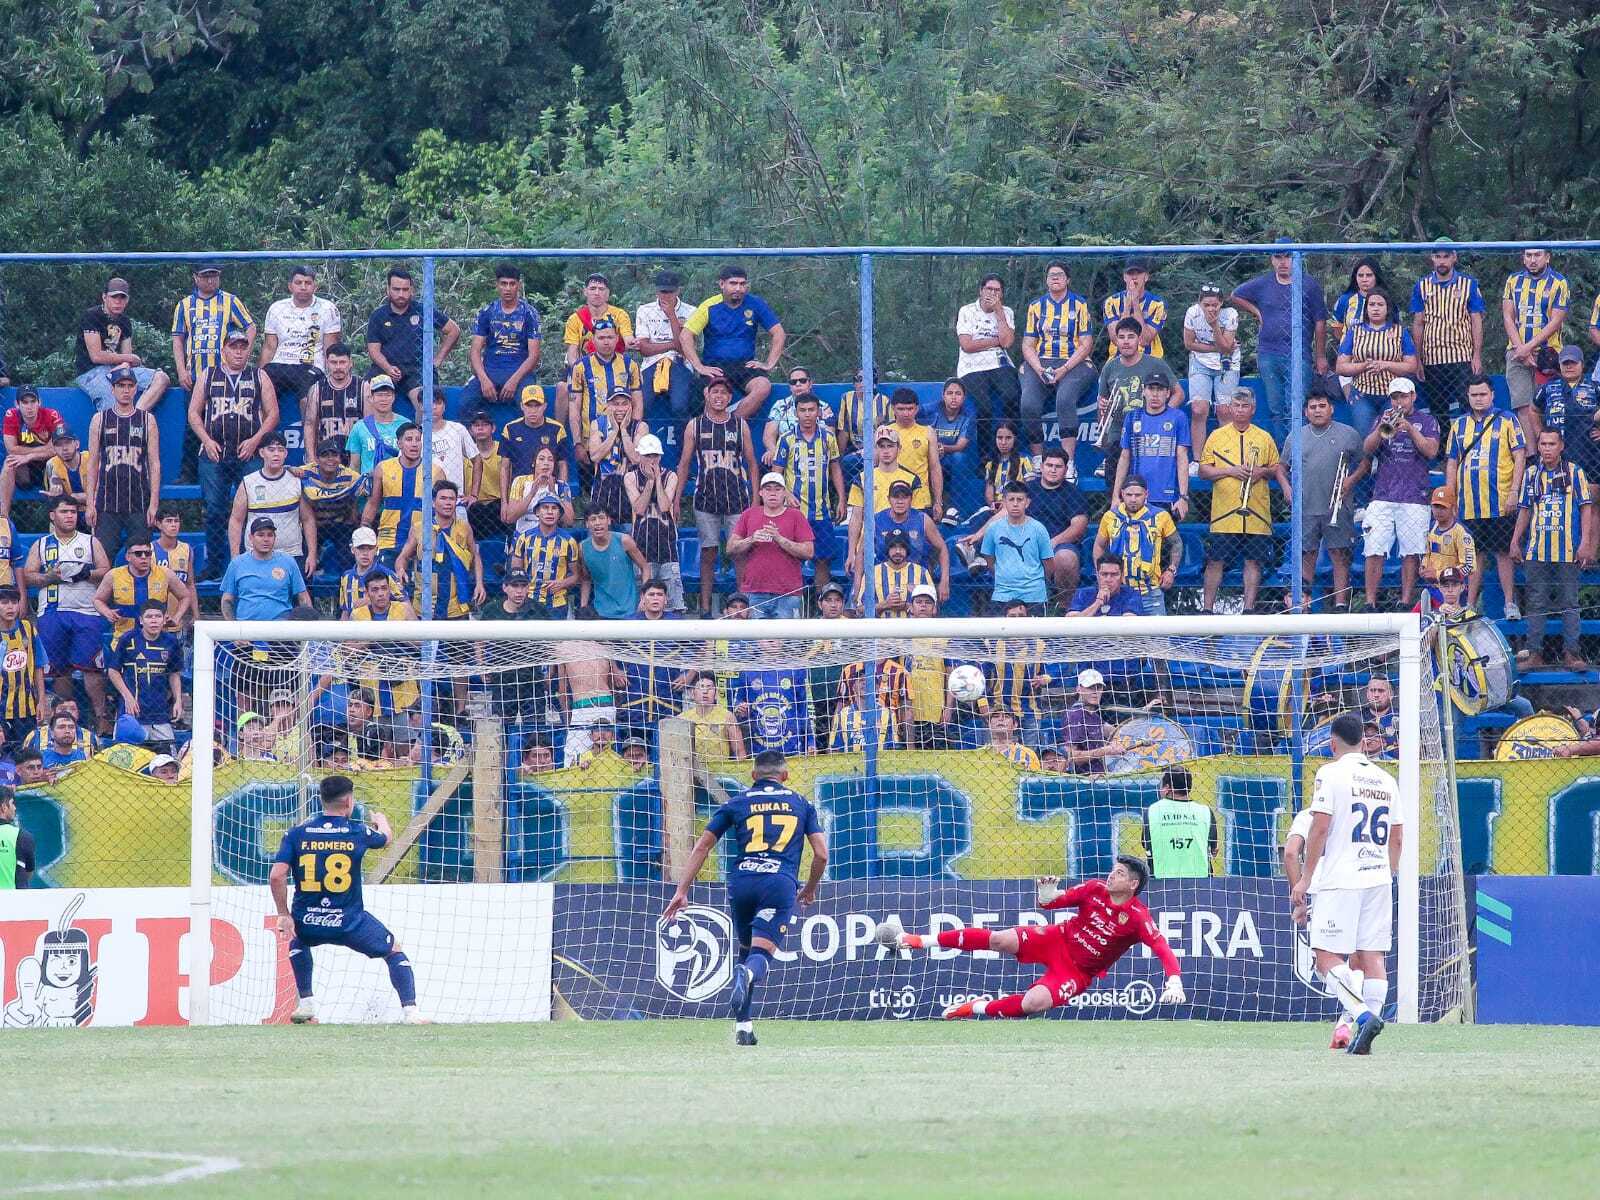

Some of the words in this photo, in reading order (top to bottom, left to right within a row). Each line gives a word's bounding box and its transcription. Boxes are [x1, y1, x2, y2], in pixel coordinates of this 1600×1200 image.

[1144, 433, 1161, 448] 12
[745, 815, 799, 853] 17
[1351, 802, 1390, 846] 26
[1169, 837, 1193, 850] 157
[299, 853, 352, 893] 18
